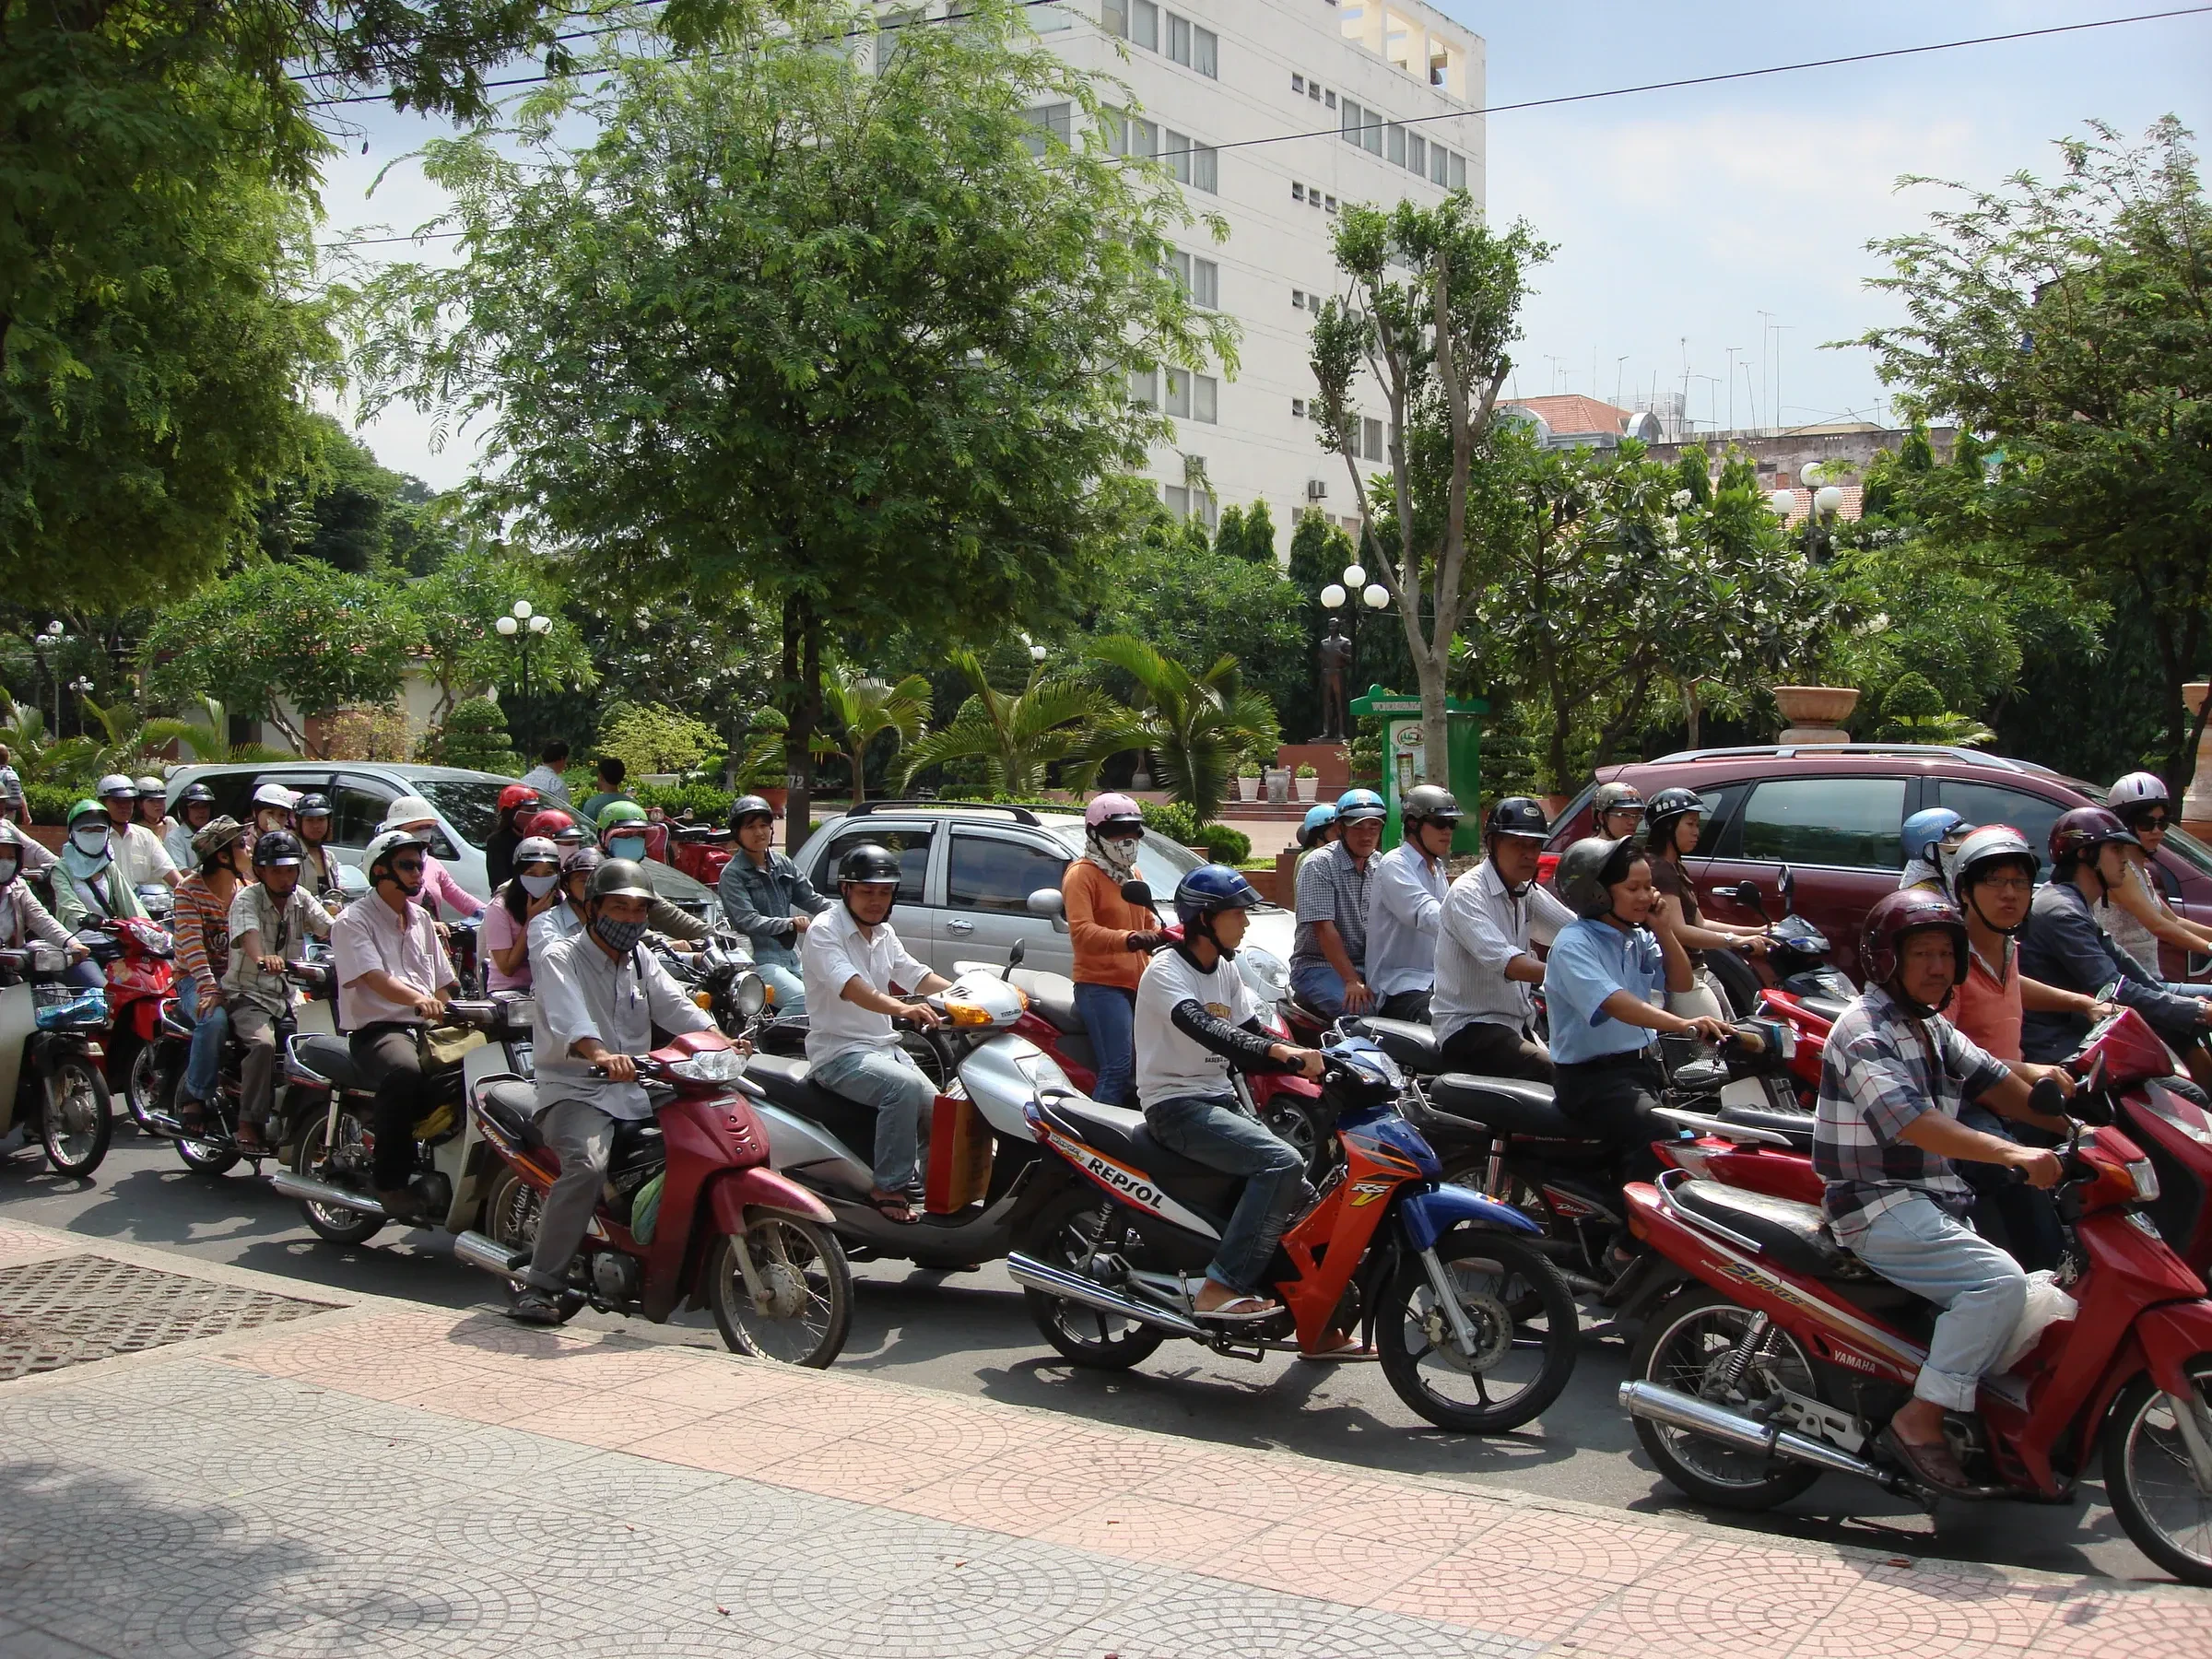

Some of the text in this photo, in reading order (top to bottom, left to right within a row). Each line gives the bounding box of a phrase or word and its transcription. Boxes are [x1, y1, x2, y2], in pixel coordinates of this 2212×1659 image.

[789, 775, 804, 790] 72
[1206, 1019, 1237, 1042] BASIC
[1088, 1157, 1163, 1209] REPSOL
[1718, 1262, 1806, 1305] Sirius
[1834, 1350, 1876, 1373] YAMAHA
